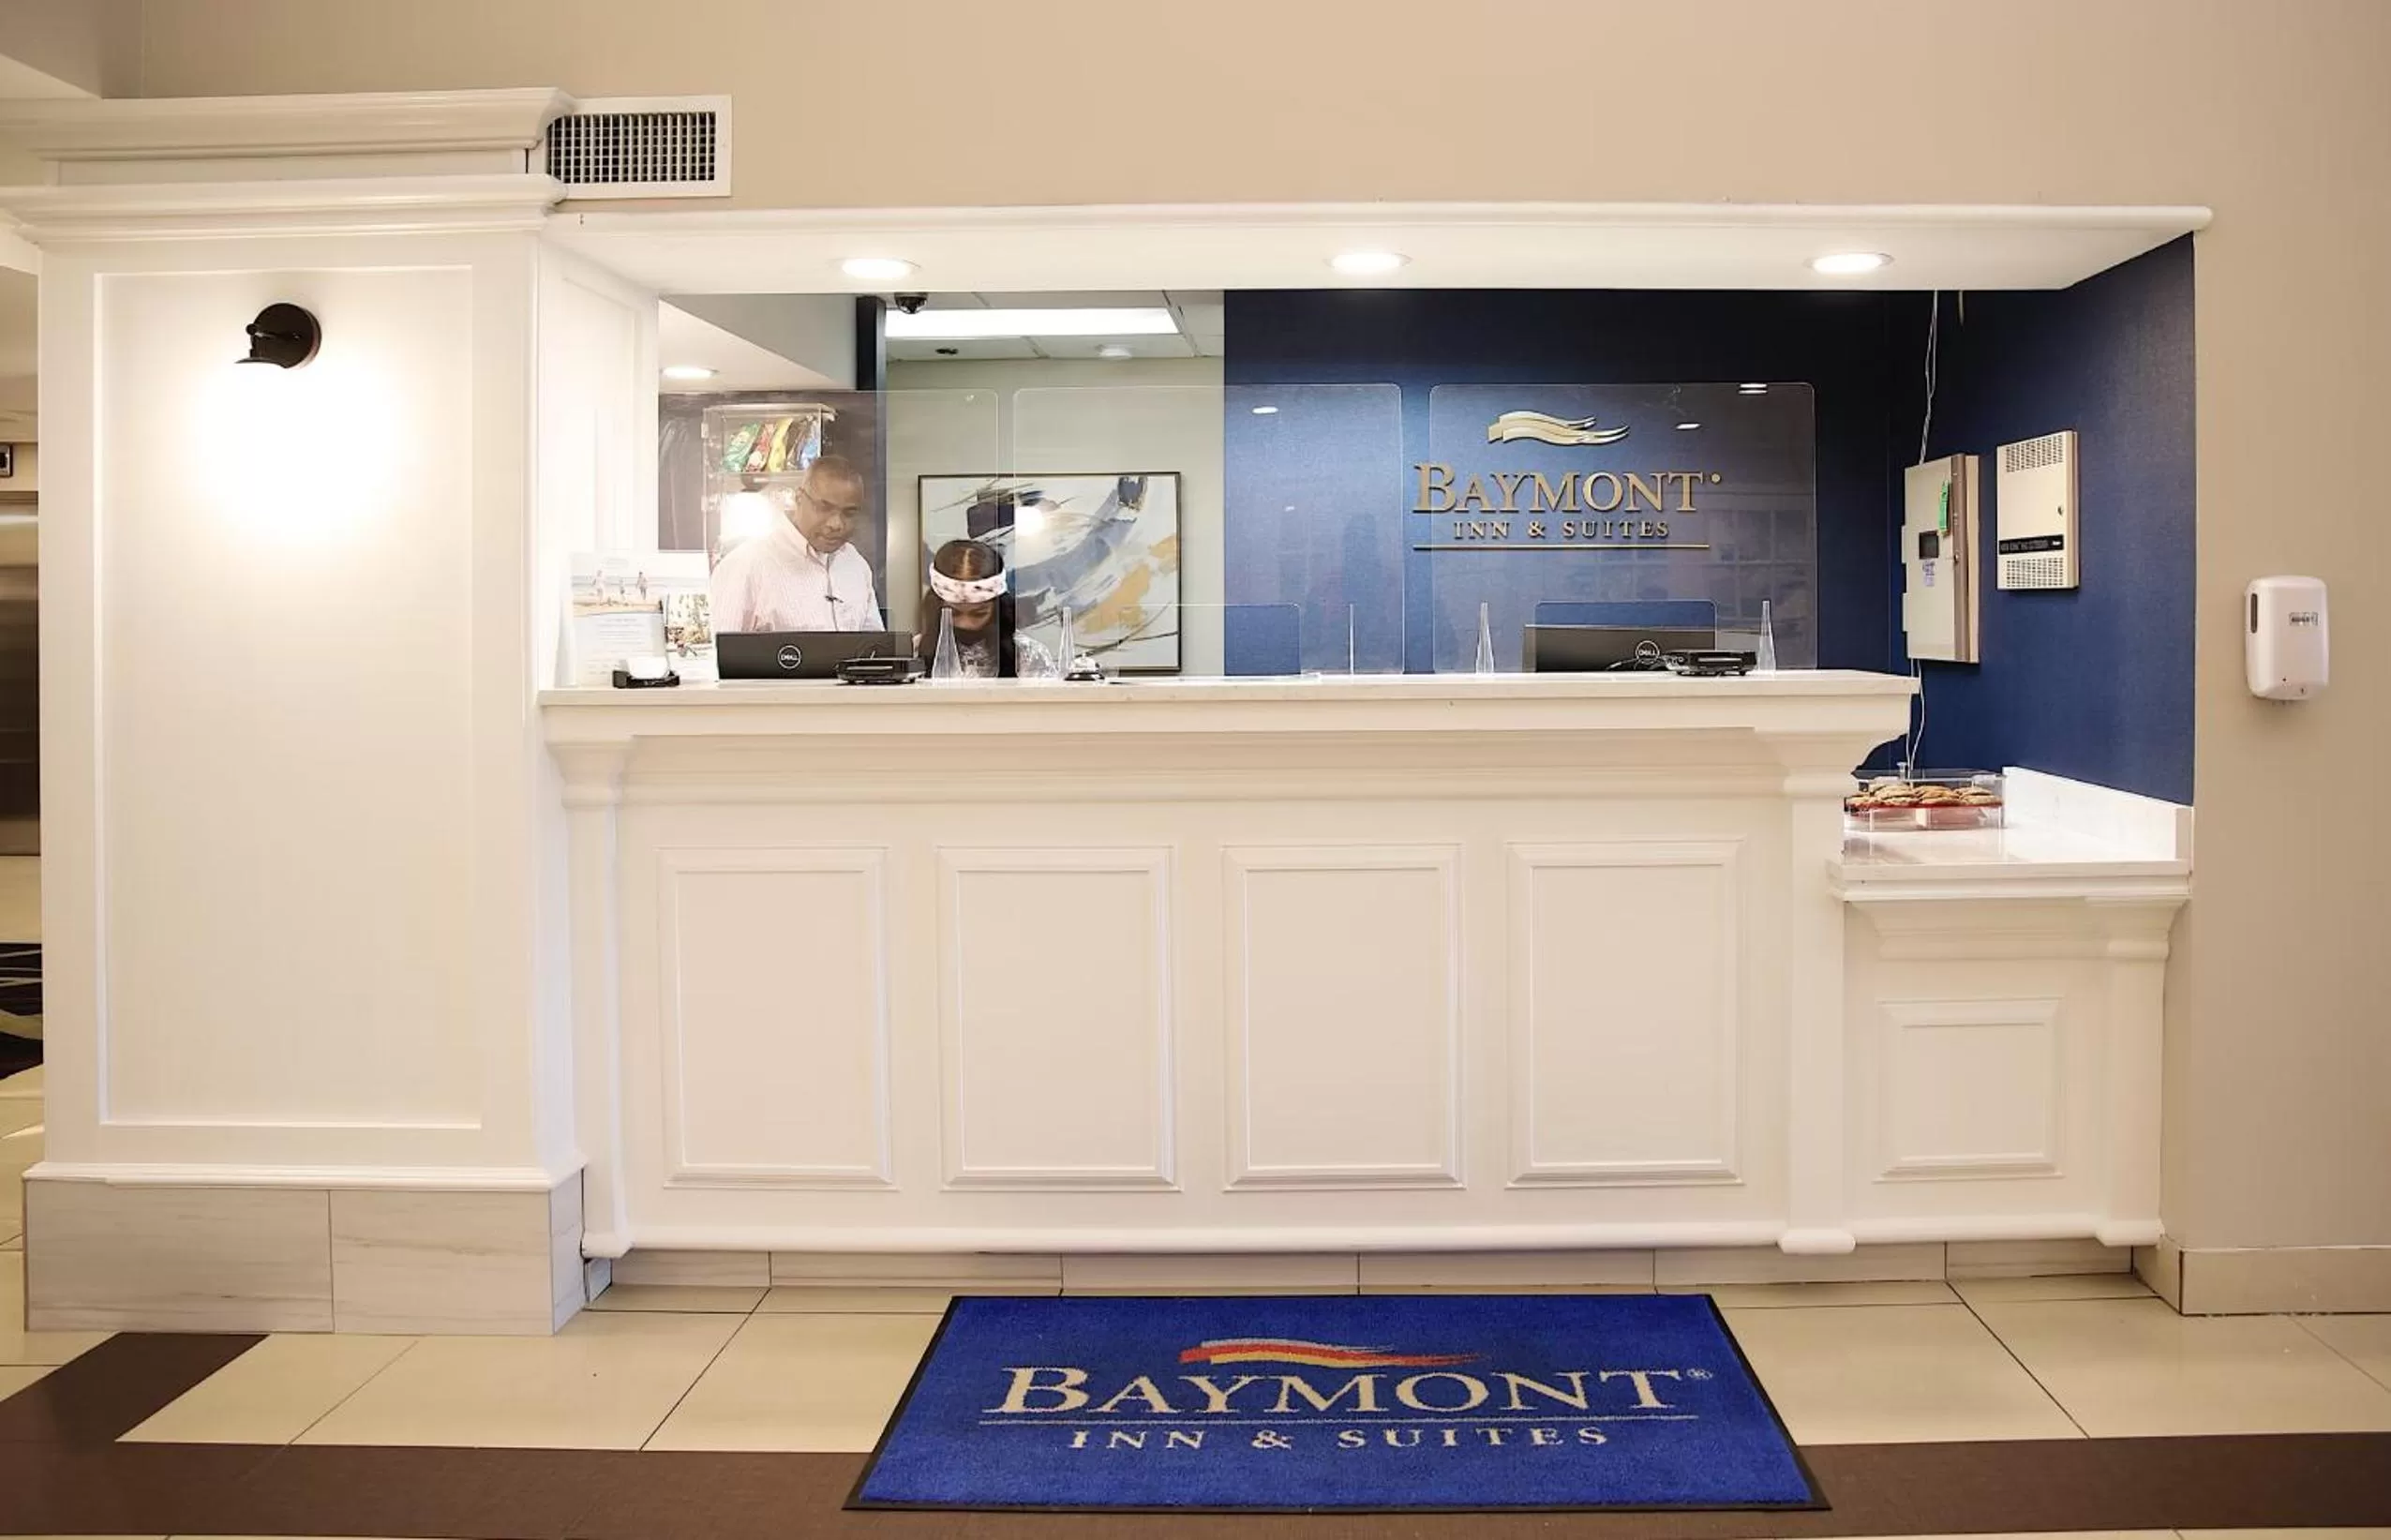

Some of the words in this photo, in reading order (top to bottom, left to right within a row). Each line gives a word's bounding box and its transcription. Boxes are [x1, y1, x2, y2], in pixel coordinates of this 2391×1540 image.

[1455, 520, 1510, 540] INN
[1527, 520, 1547, 538] &
[1562, 520, 1668, 539] SUITES
[1068, 1429, 1204, 1449] INN
[1250, 1429, 1295, 1450] &
[1337, 1427, 1608, 1449] SUITES
